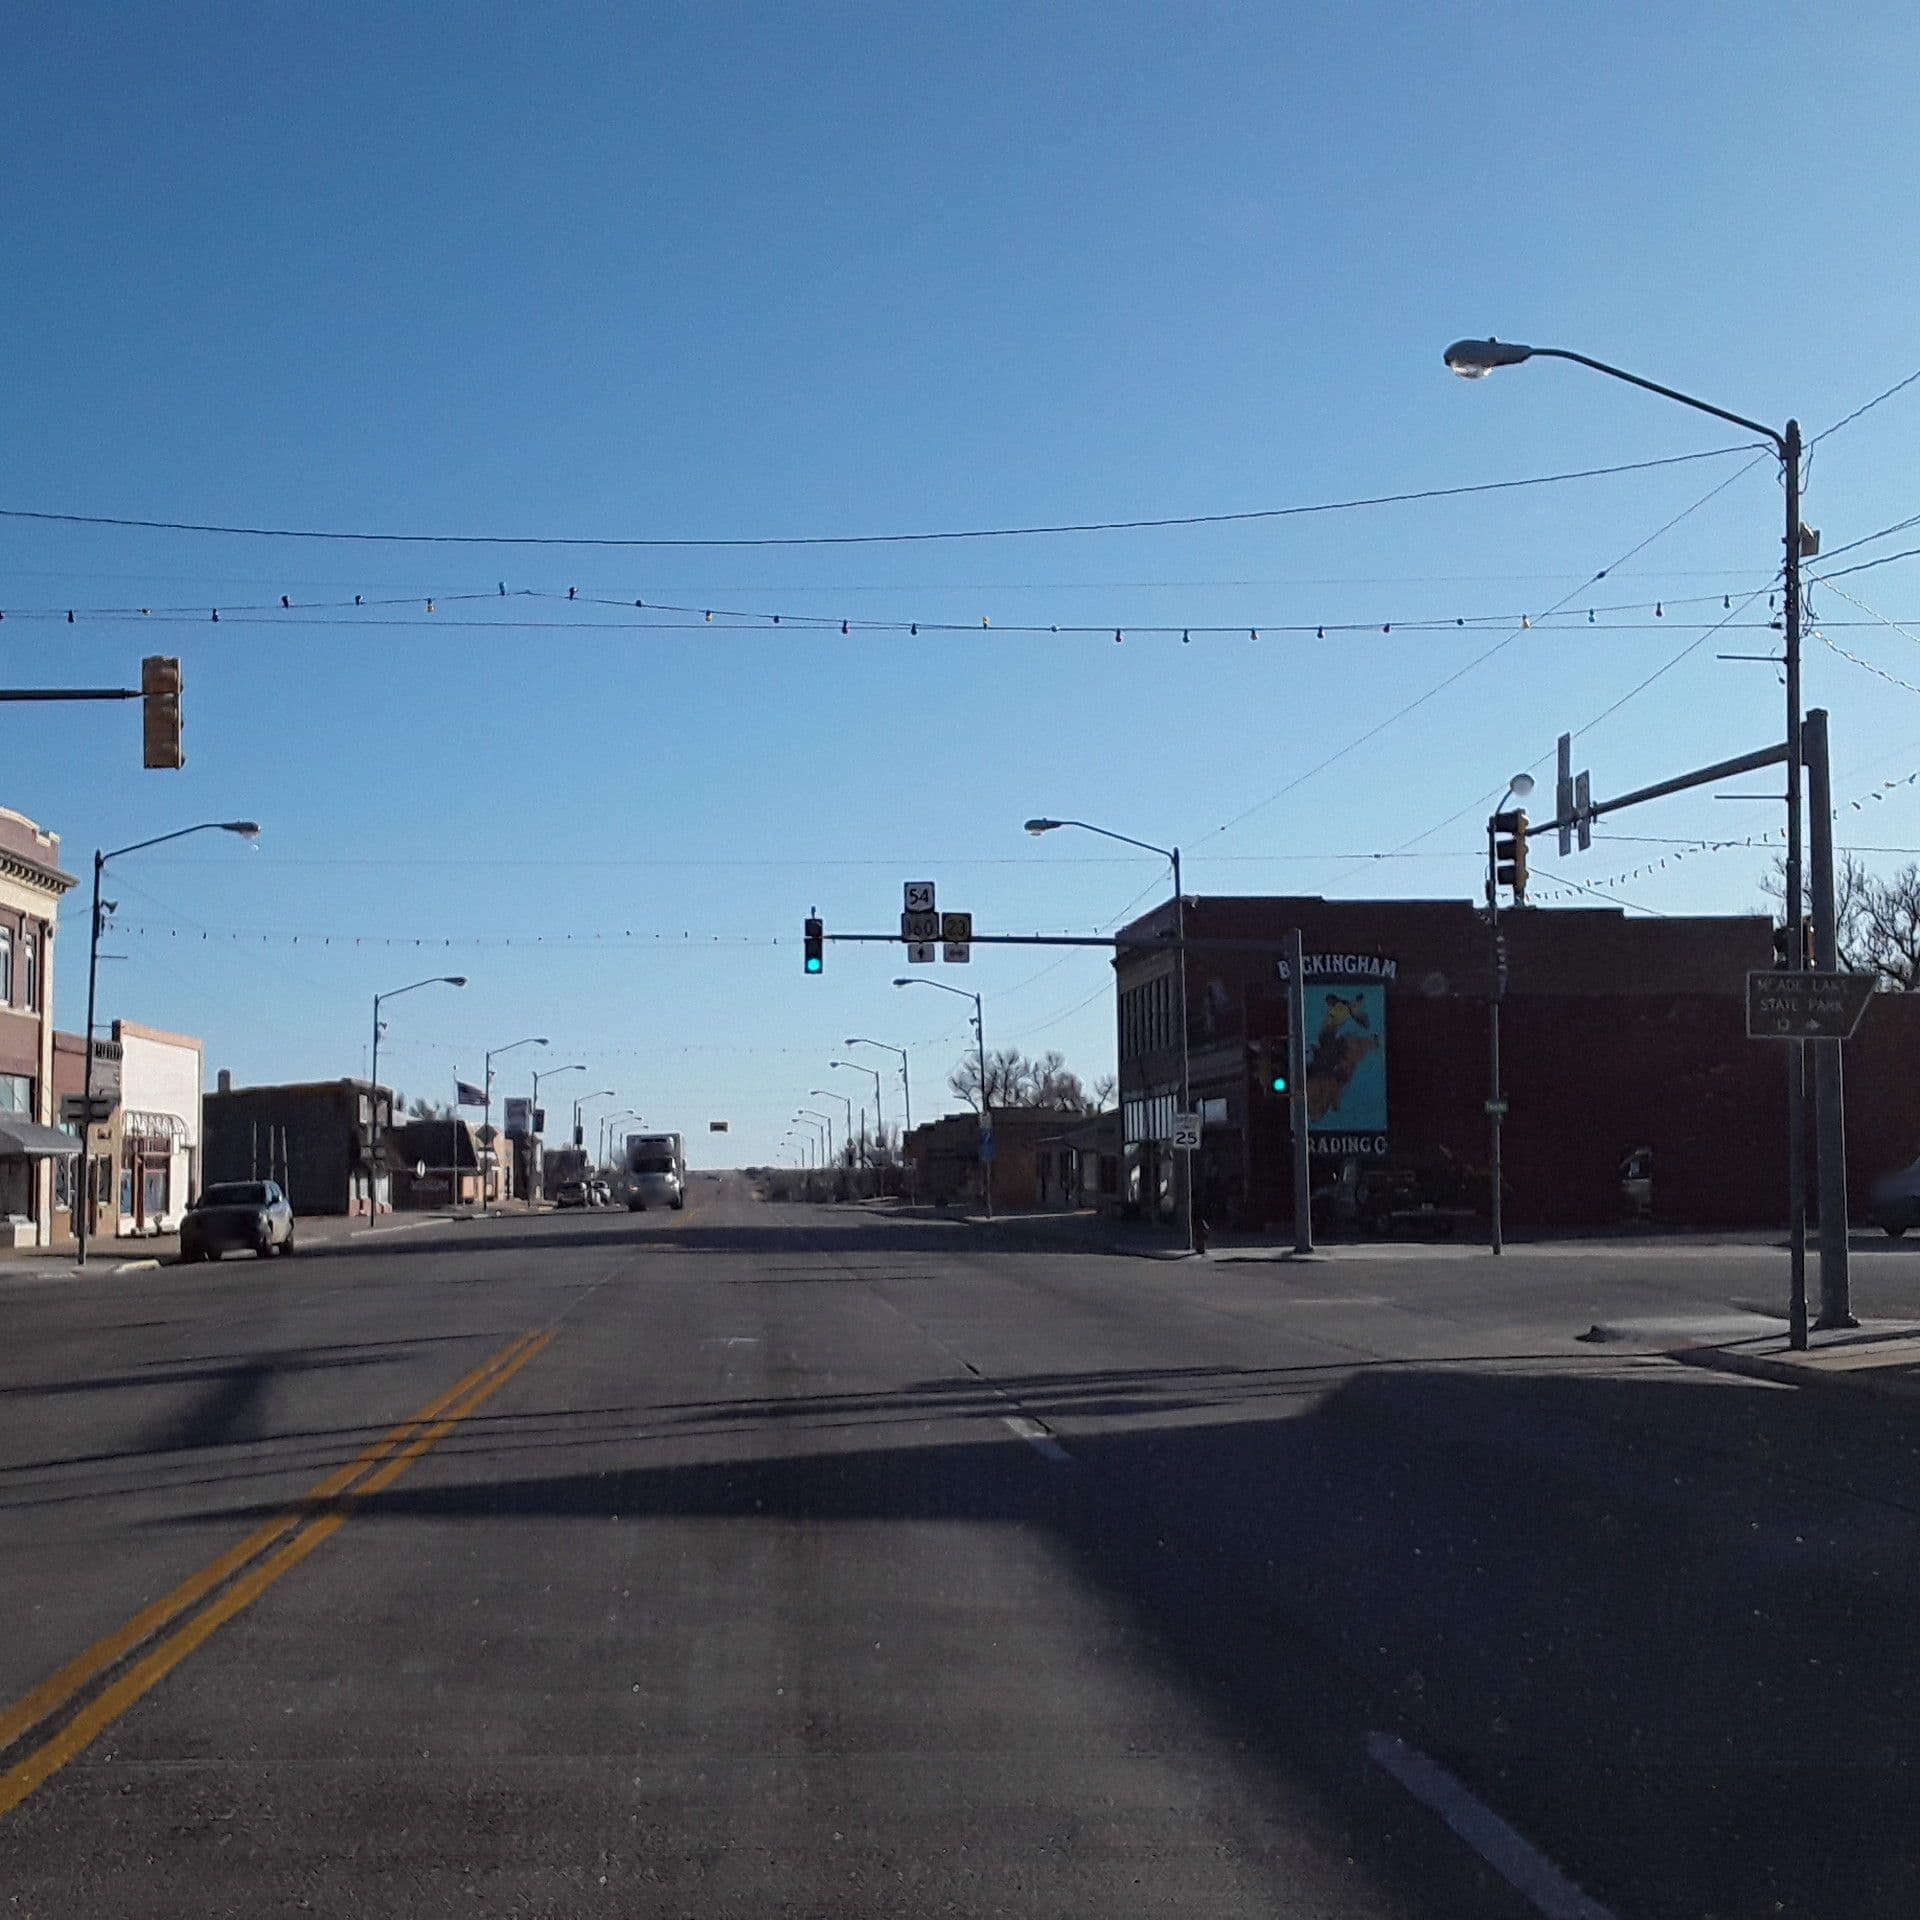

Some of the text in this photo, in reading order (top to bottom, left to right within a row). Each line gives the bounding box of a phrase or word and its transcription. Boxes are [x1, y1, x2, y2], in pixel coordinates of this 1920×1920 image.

[909, 888, 929, 905] 54
[1277, 953, 1397, 979] BCKINGHAM
[1176, 1131, 1198, 1145] 25
[1306, 1136, 1370, 1153] RADING
